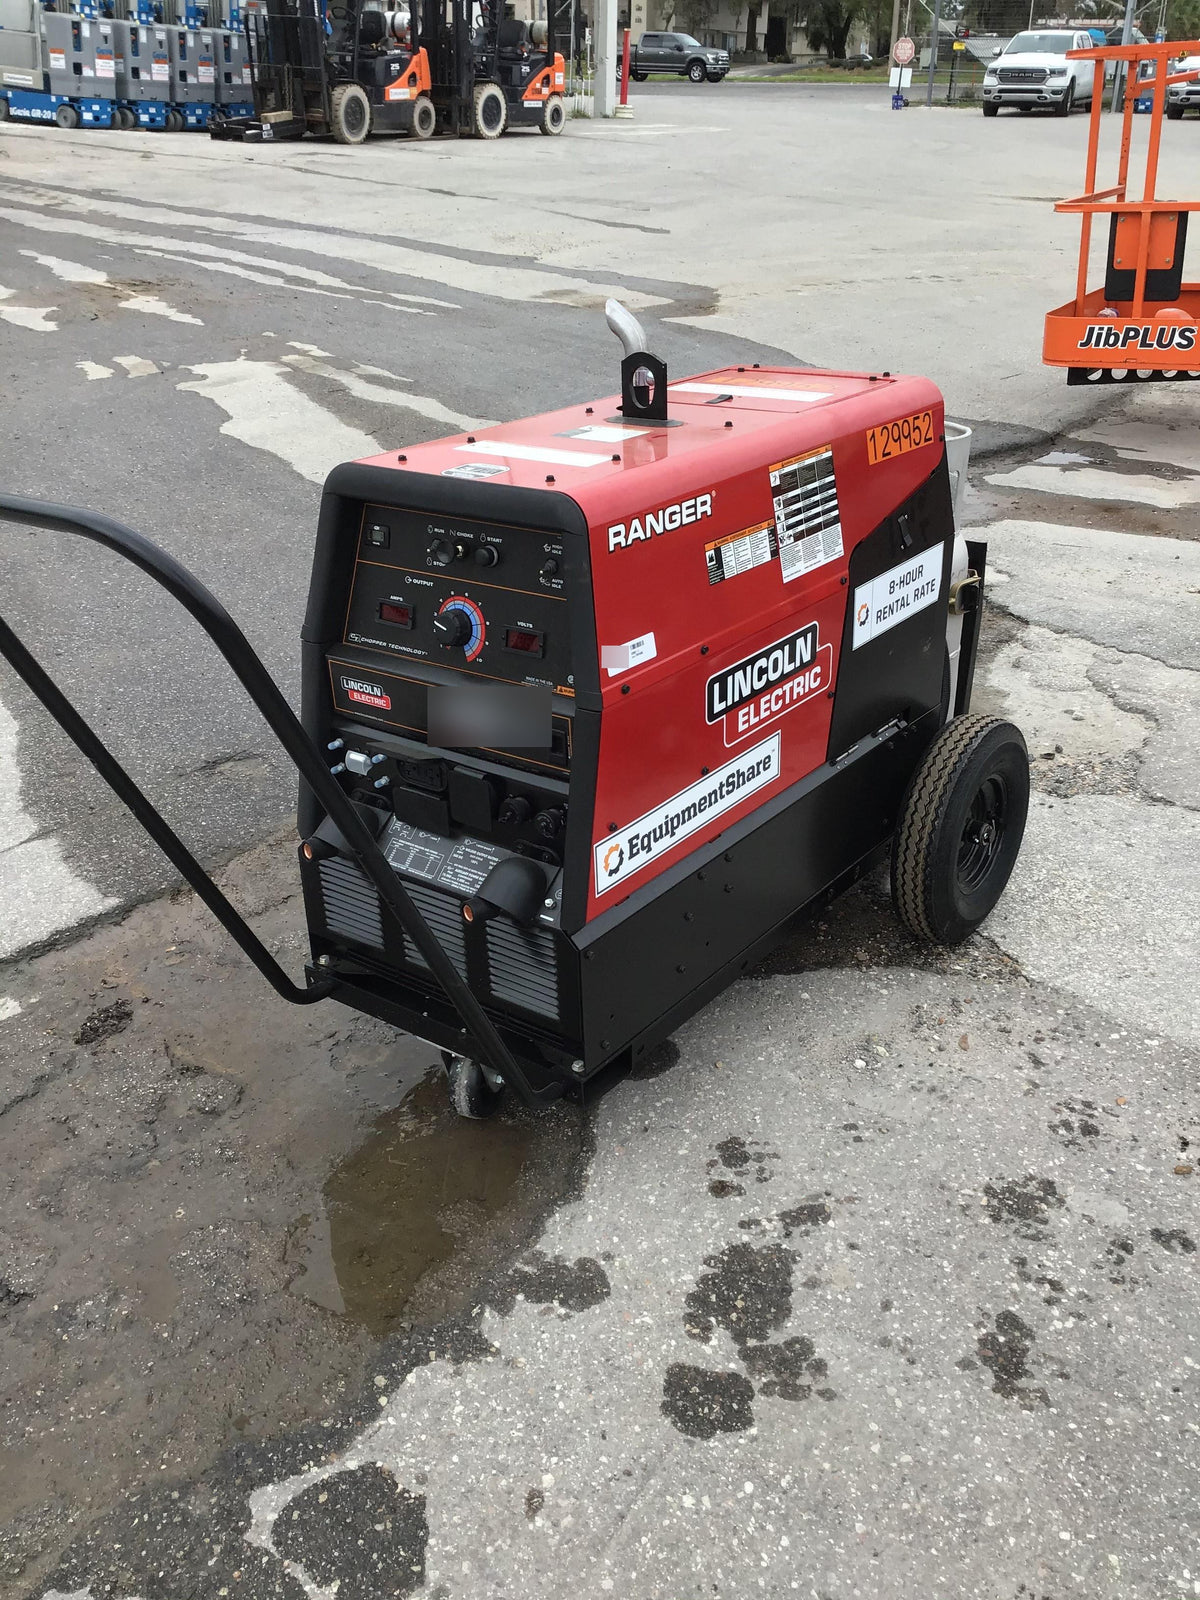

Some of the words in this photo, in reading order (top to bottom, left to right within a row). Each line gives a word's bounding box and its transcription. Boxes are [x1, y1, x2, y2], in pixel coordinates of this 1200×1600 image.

[1078, 325, 1197, 350] JibPLUS
[870, 412, 932, 460] 129952
[608, 493, 712, 552] RANGER
[876, 594, 910, 624] RENTAL
[914, 578, 936, 602] RATE
[889, 565, 924, 595] 8-HOUR
[360, 637, 387, 647] CHOPPER
[388, 643, 426, 655] TECHNOLOGY
[343, 679, 380, 696] LINCOLN
[714, 632, 812, 714] LINCOLN
[354, 692, 386, 706] ELECTRIC
[738, 666, 821, 733] ELECTRIC
[628, 754, 771, 861] EquipmentShare
